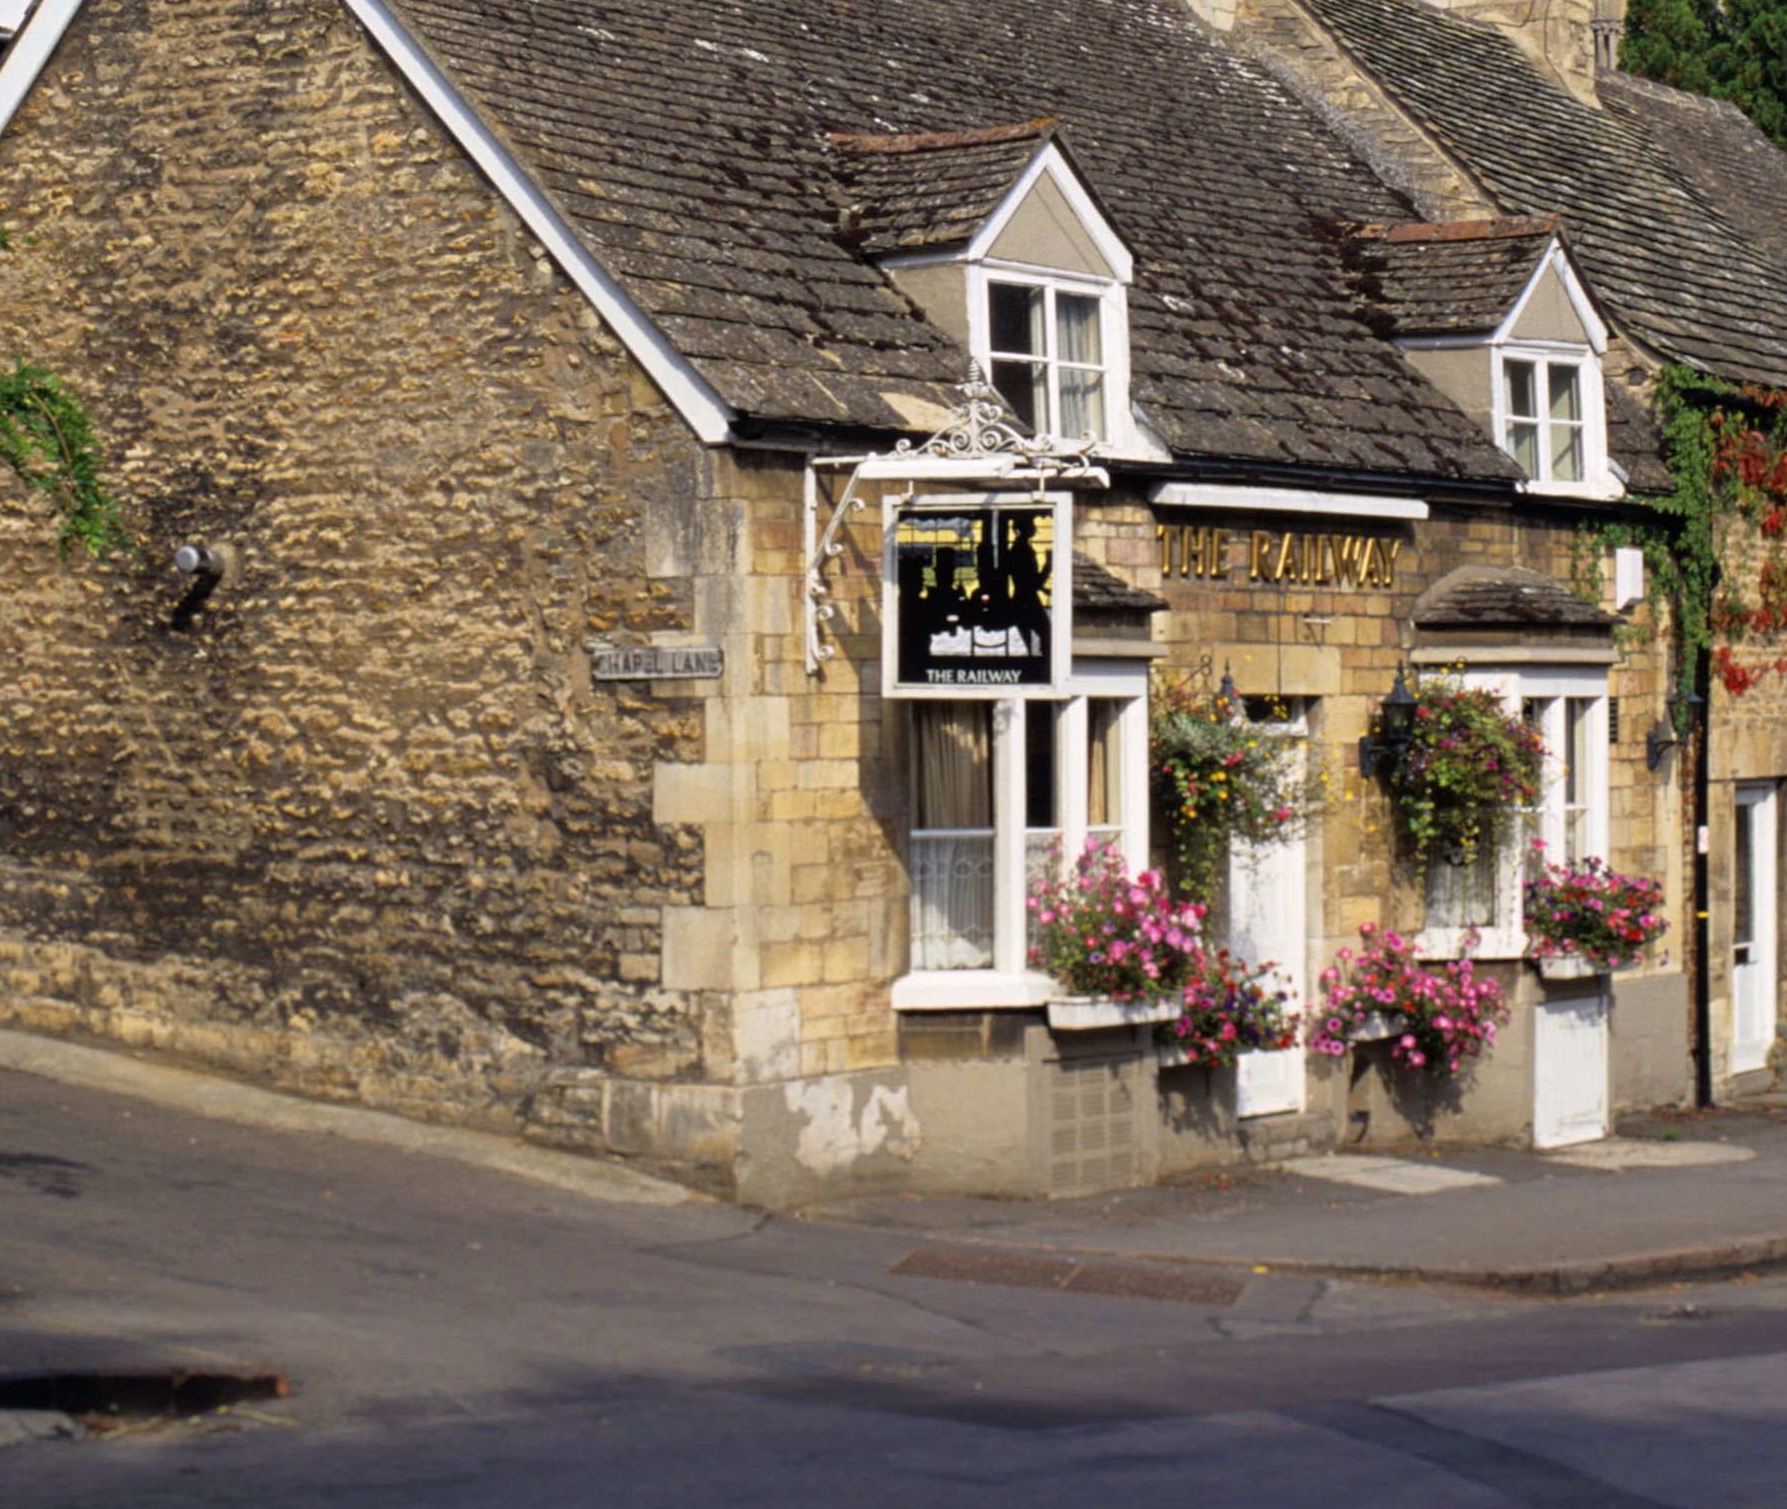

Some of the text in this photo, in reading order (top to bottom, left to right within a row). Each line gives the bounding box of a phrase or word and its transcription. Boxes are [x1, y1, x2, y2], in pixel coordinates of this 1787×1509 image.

[1156, 524, 1403, 586] THE RAILWAY
[597, 651, 719, 675] CHAPEL LANE
[926, 669, 1022, 684] THE RAILWAY
